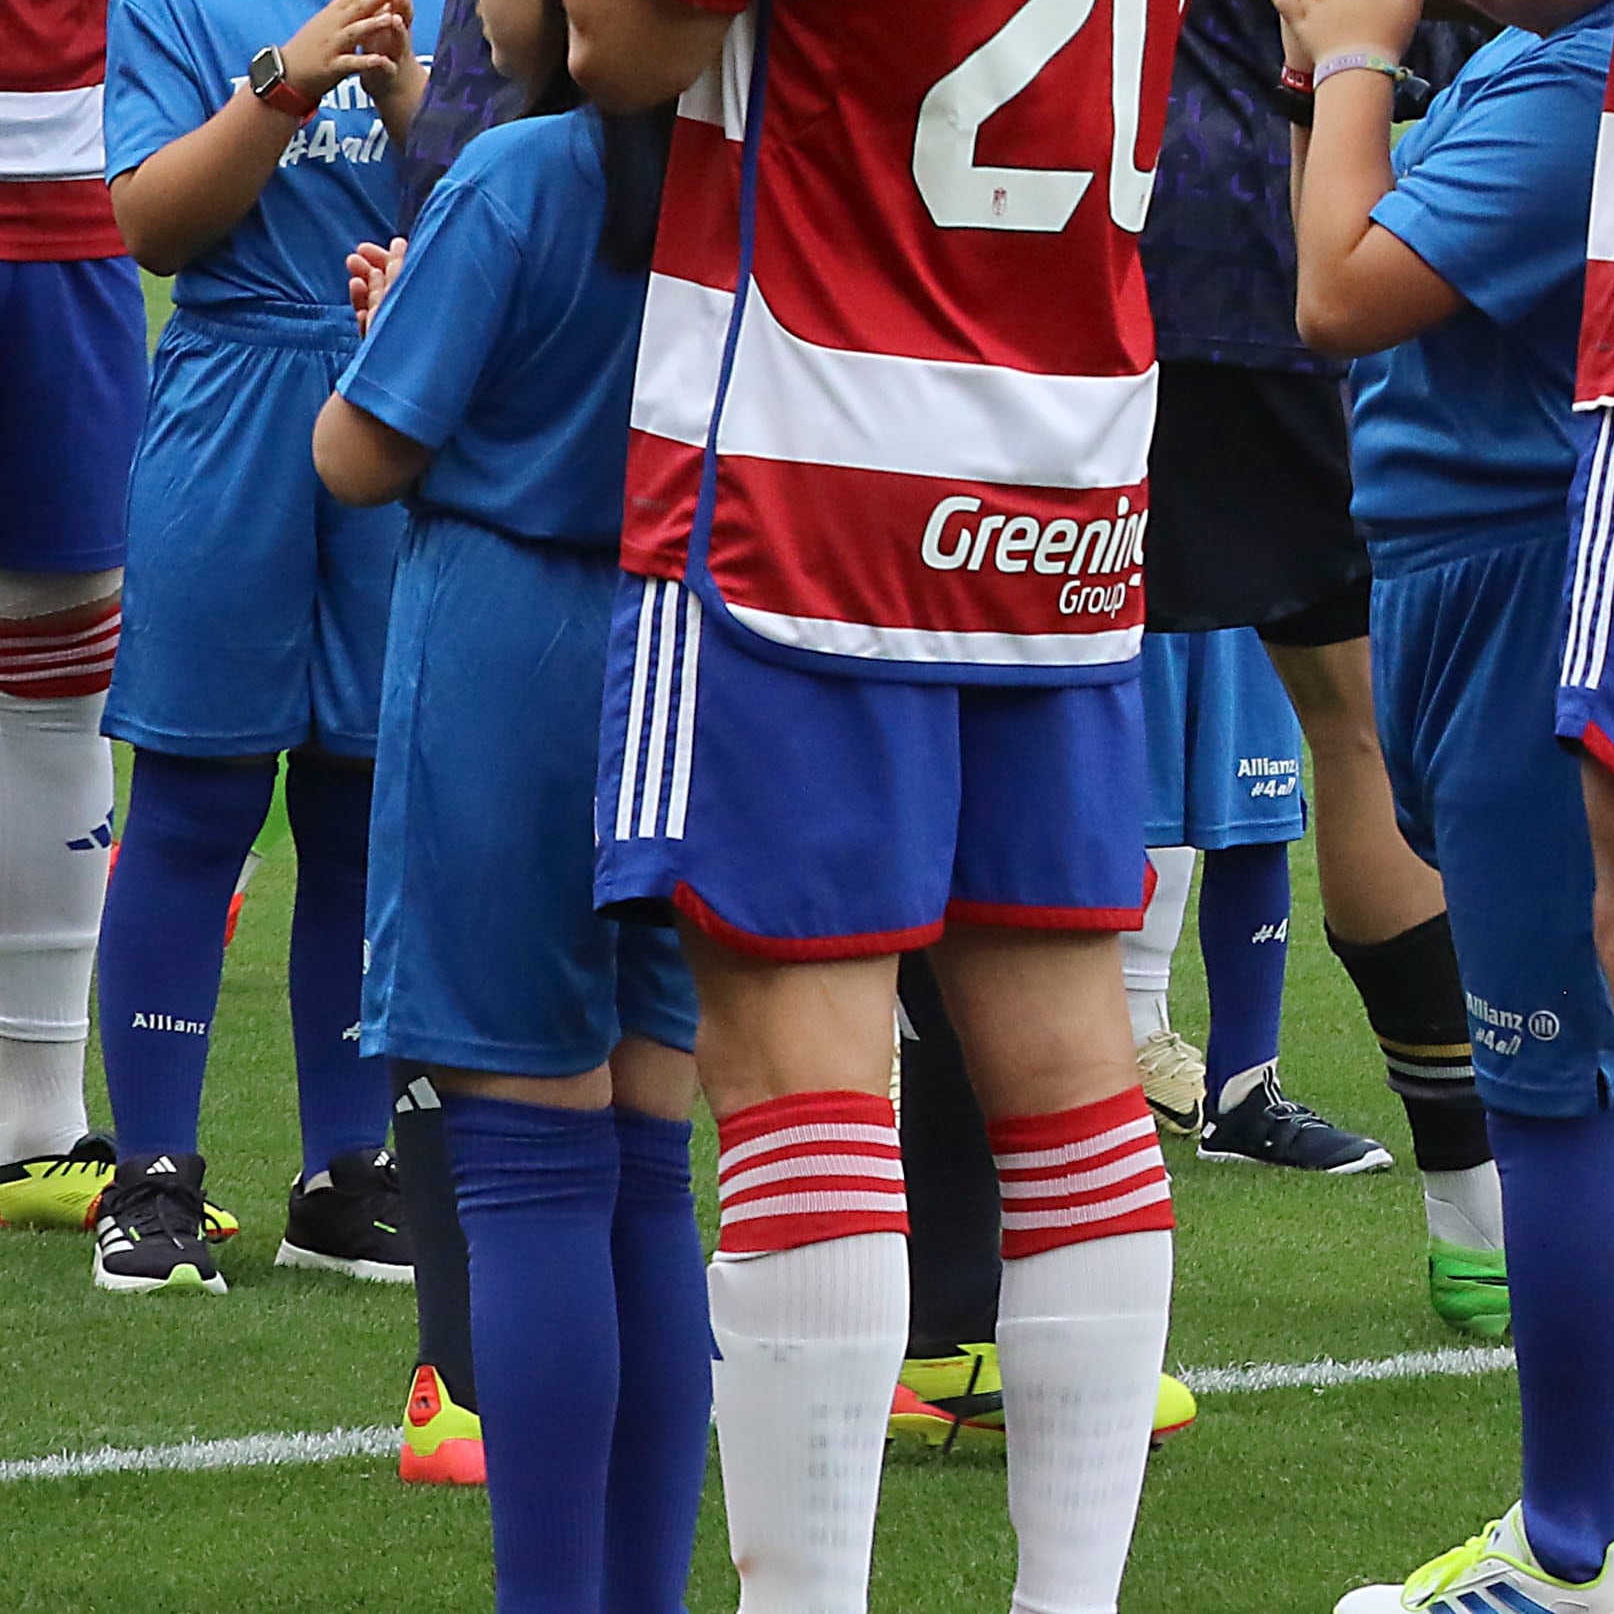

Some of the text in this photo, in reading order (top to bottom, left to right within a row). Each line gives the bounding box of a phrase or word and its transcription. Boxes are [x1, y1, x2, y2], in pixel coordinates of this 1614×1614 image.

[1058, 580, 1126, 619] Group
[1237, 758, 1297, 778] Allianz
[132, 1013, 206, 1035] Allianz
[1466, 991, 1523, 1031] Allianz
